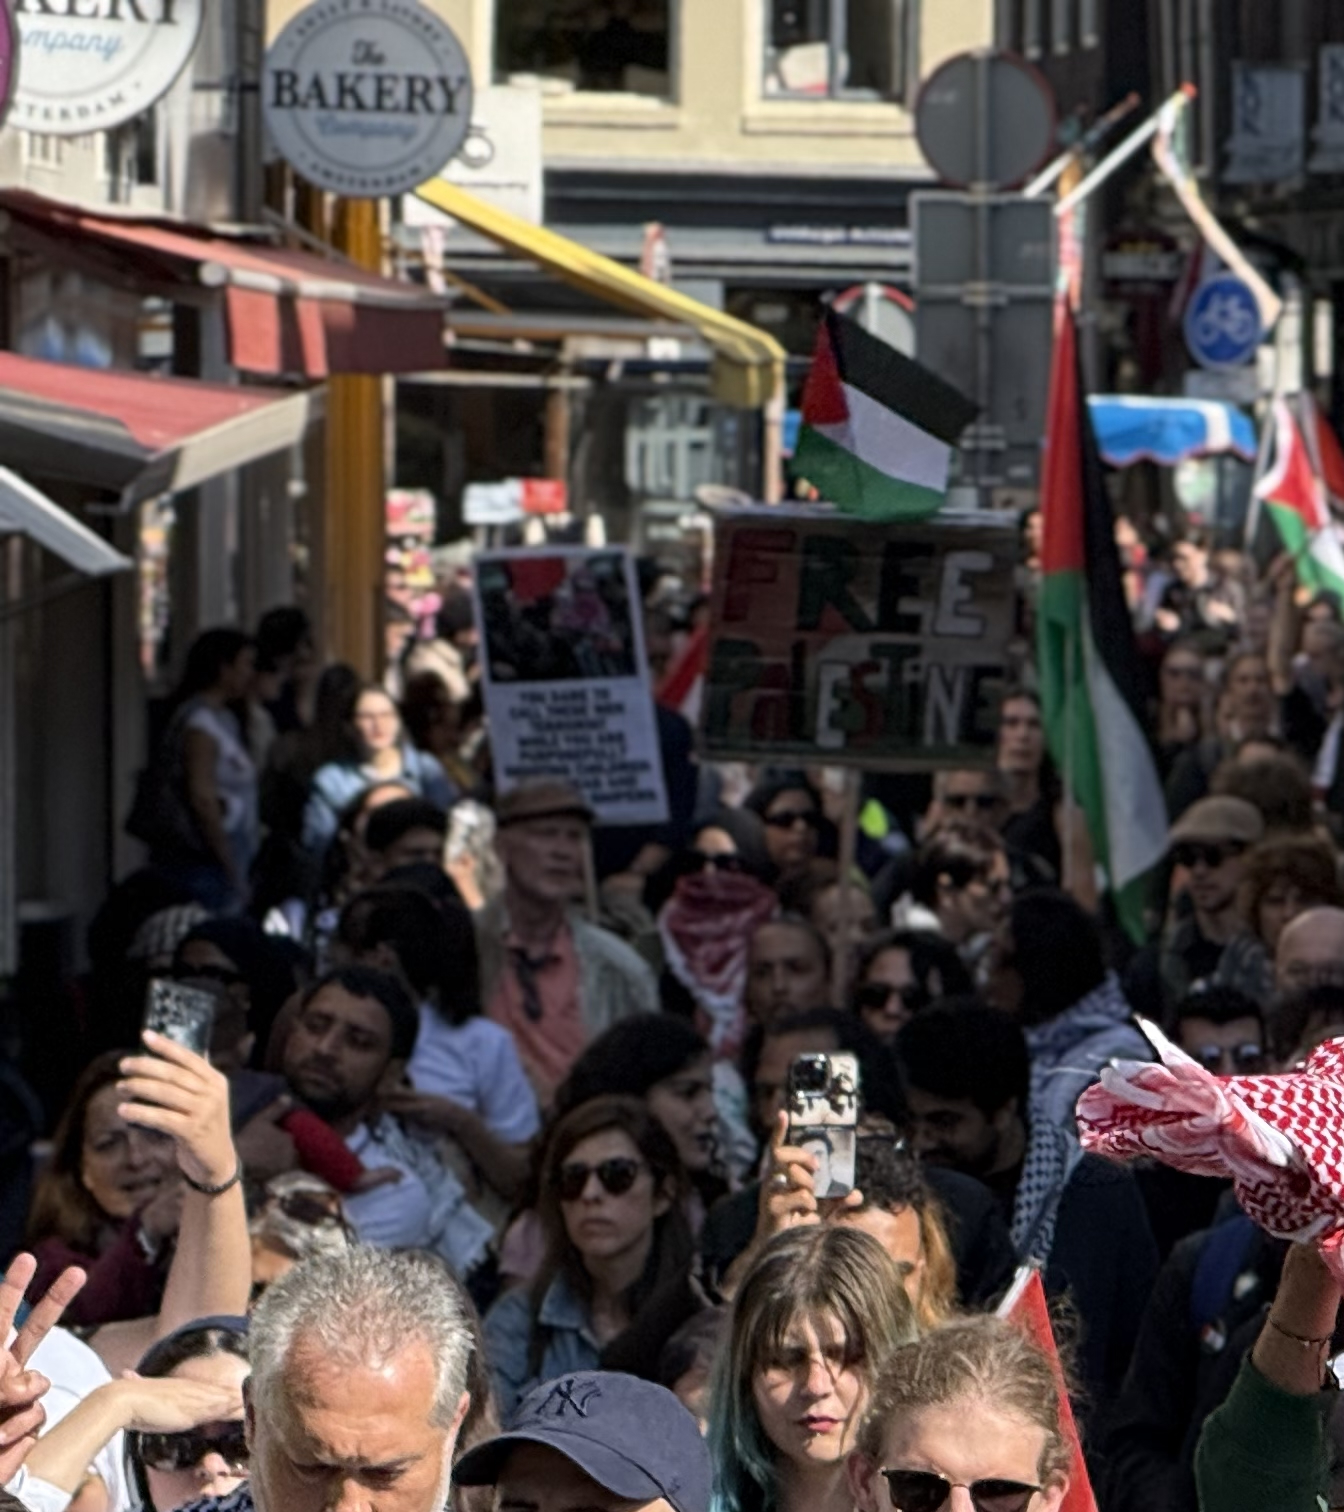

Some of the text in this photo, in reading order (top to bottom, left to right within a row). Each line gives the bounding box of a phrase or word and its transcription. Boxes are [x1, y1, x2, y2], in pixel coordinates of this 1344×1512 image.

[24, 29, 121, 62] mpany
[13, 91, 125, 121] TERDAM
[271, 69, 467, 115] BAKERY
[722, 527, 997, 638] FREE
